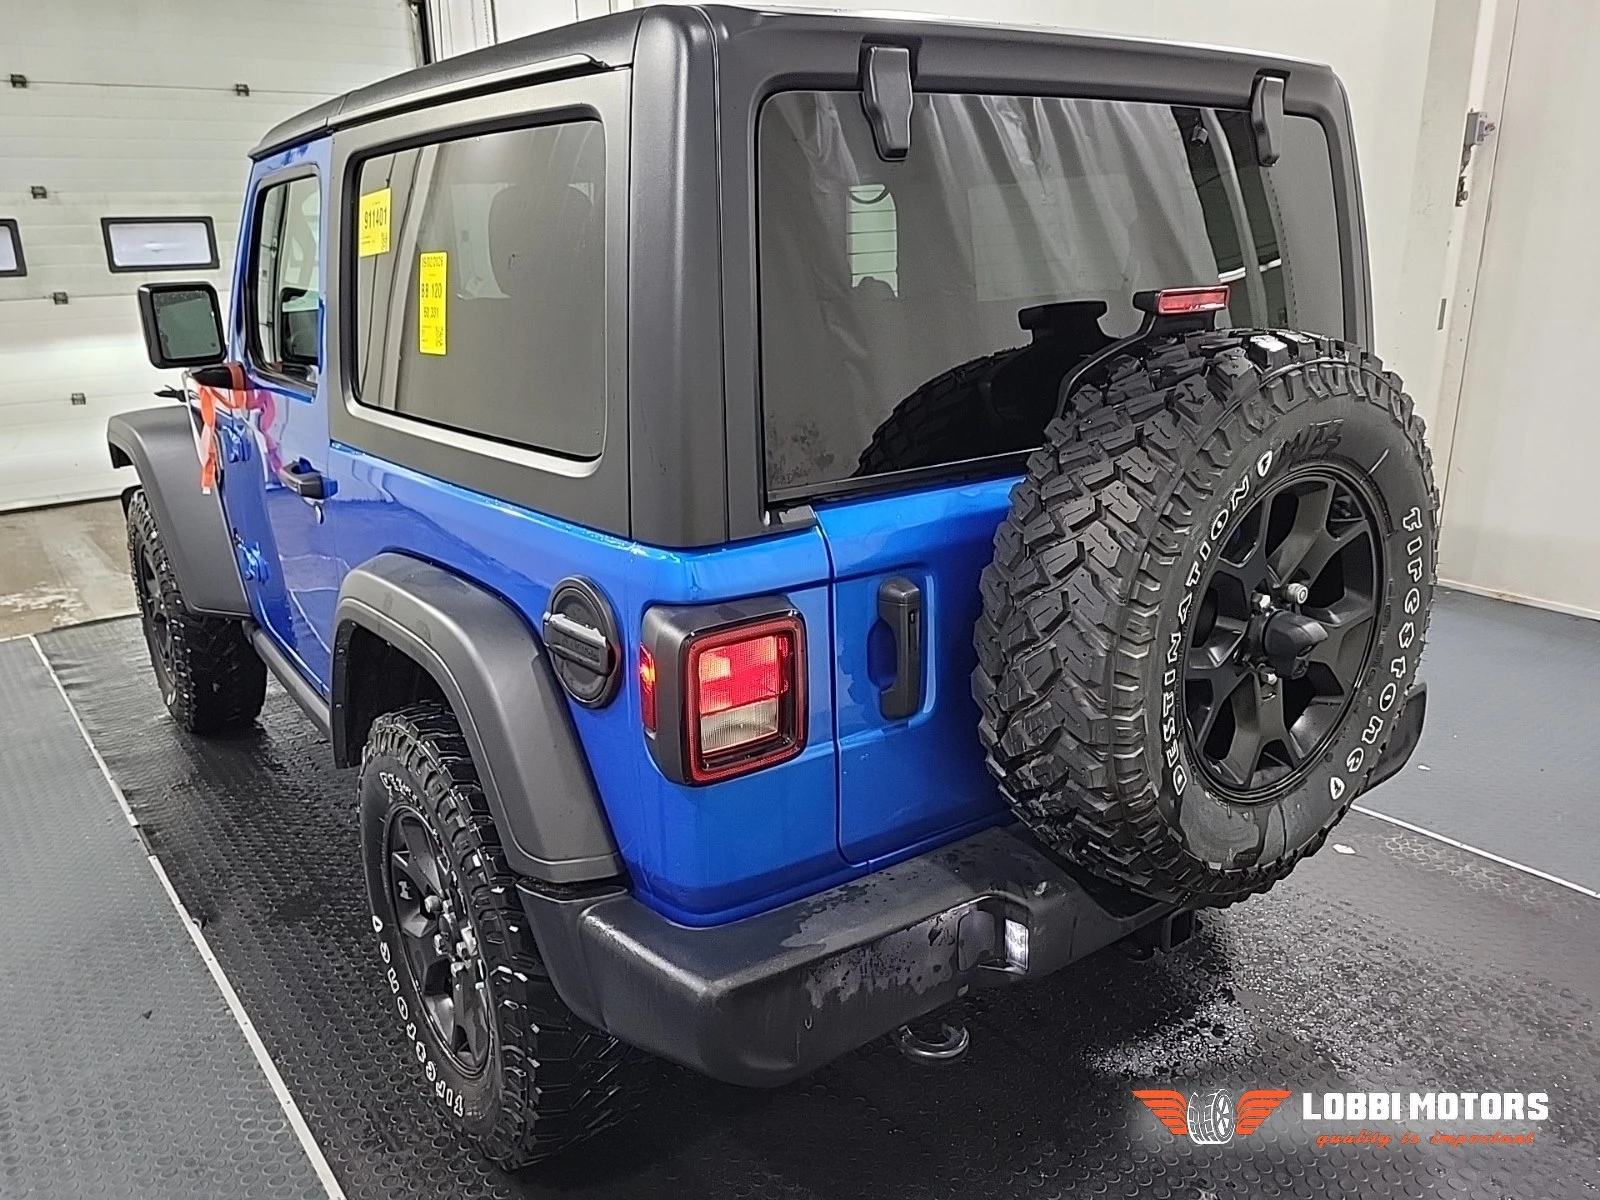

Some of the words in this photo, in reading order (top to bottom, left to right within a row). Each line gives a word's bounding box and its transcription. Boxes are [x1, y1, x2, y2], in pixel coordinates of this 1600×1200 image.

[364, 206, 387, 230] 911401
[431, 283, 443, 299] 120
[1162, 475, 1250, 796] DESTINATION
